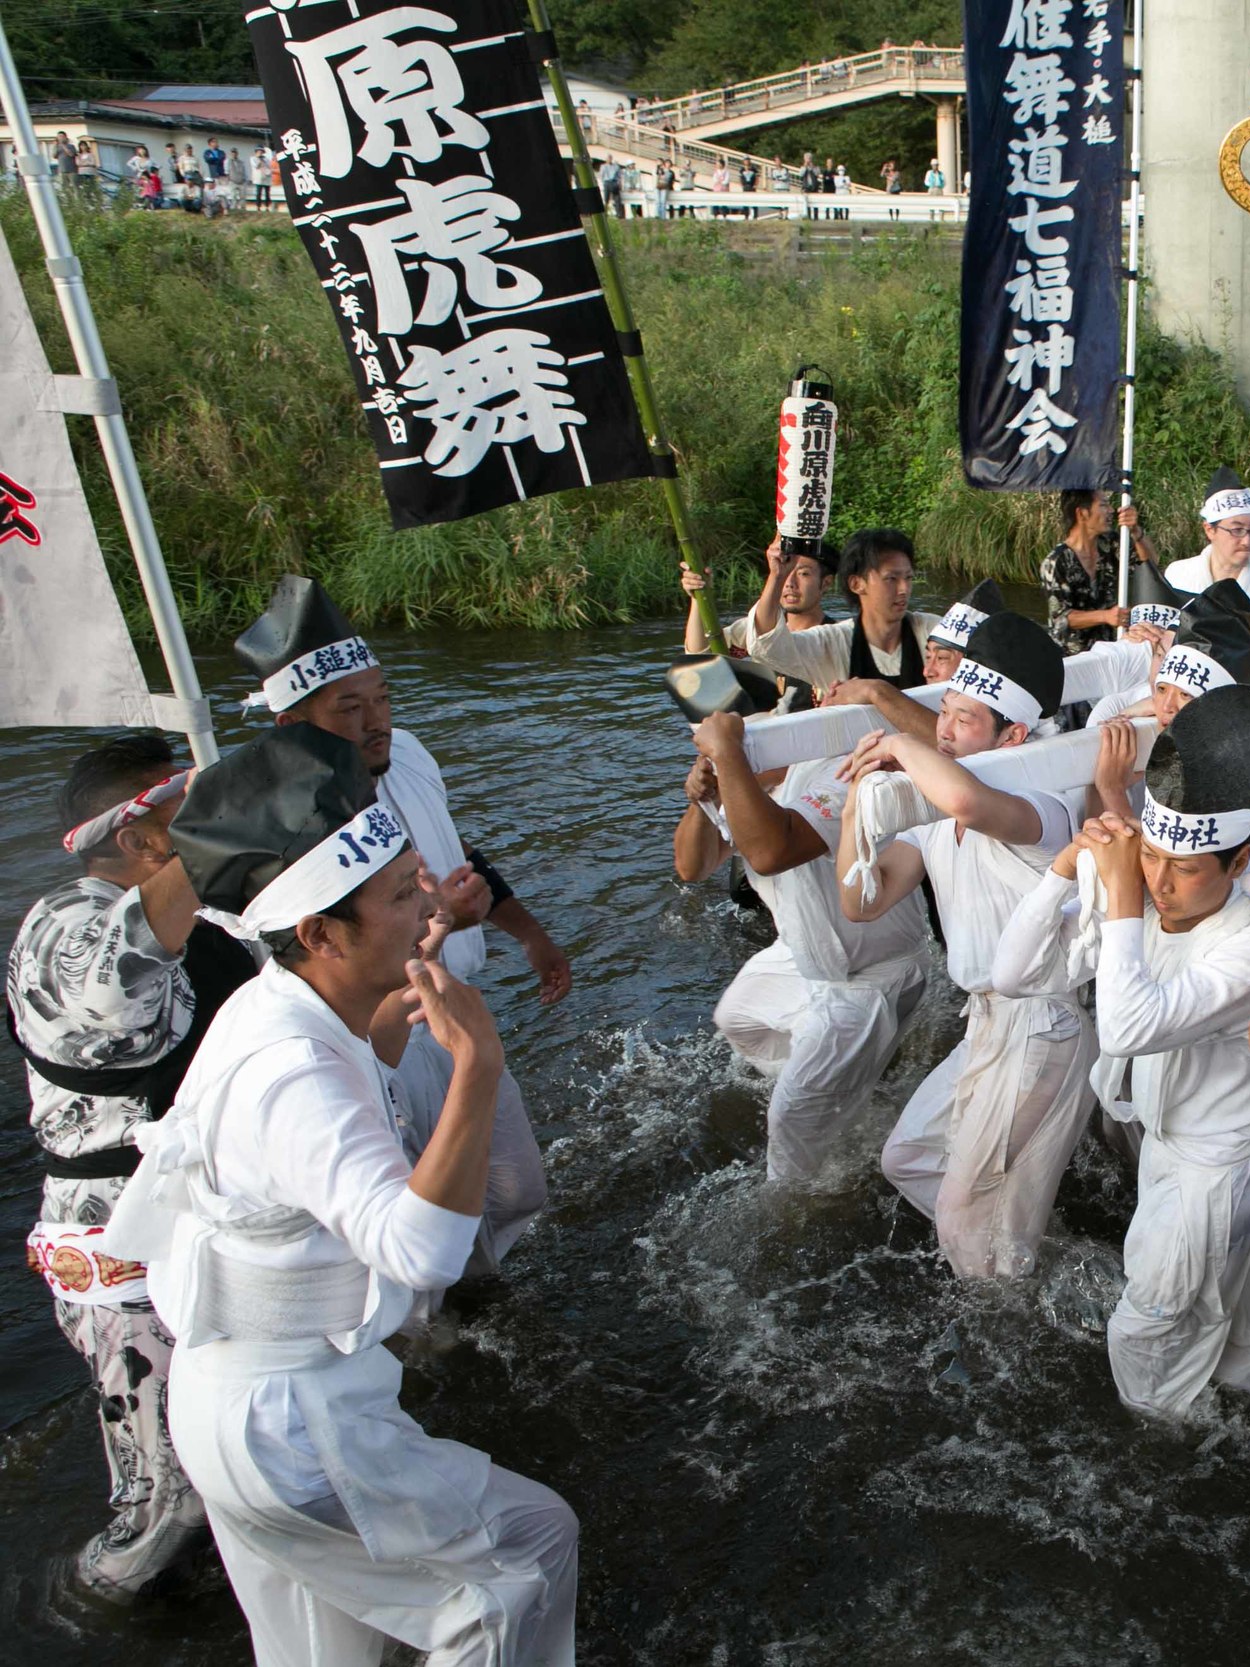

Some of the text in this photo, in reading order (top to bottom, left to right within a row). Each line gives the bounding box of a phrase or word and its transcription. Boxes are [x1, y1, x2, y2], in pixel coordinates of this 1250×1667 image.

[270, 0, 588, 477] 原虎舞
[280, 128, 408, 445] 平成二十三年九月吉日
[797, 401, 834, 538] 向川原虎舞
[290, 635, 379, 692] 小鎚神
[951, 663, 1004, 701] 神社
